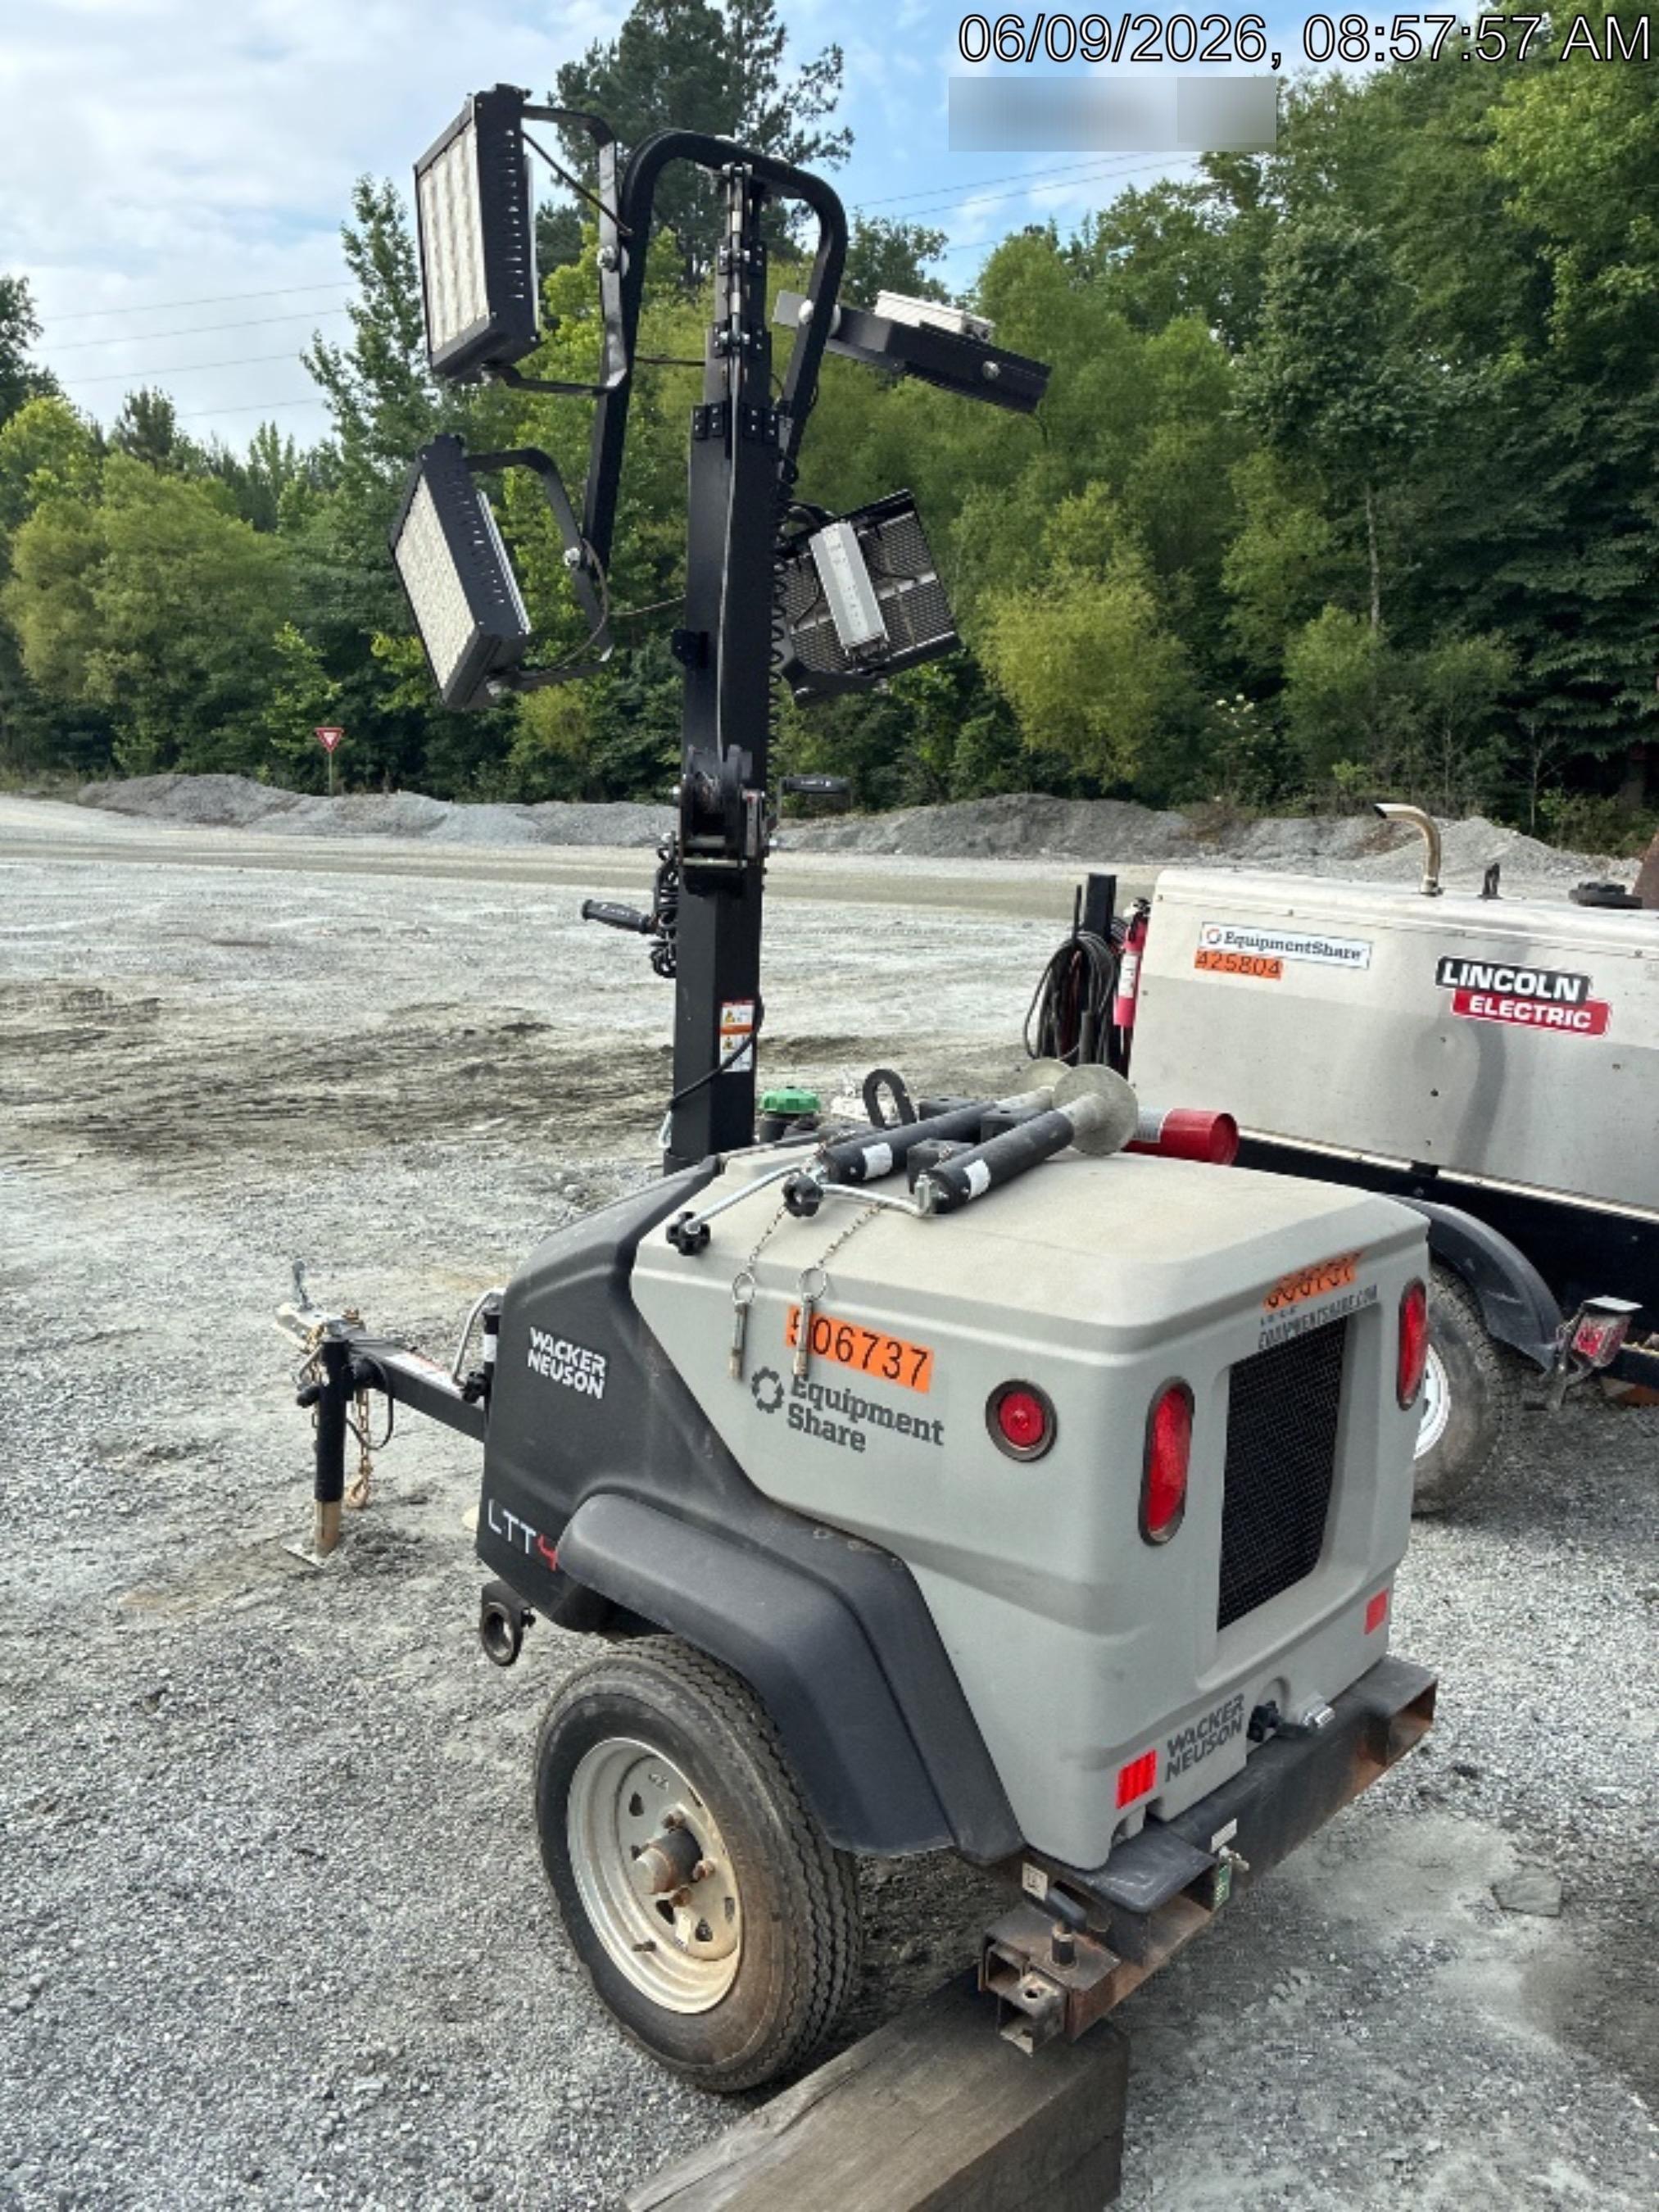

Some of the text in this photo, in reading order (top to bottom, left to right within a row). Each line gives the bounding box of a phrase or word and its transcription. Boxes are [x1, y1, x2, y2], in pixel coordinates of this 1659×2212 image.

[1196, 950, 1281, 977] 425804
[1224, 931, 1361, 961] EquipmentShare
[1442, 961, 1582, 1003] LINCOLN
[1469, 995, 1592, 1029] ELECTRIC
[528, 1349, 605, 1399] NEUSON
[529, 1326, 605, 1377] WACKER
[788, 1402, 866, 1453] Share
[791, 1375, 945, 1446] Equipment
[1165, 1711, 1244, 1783] NEUSON
[1167, 1693, 1244, 1758] WACKER
